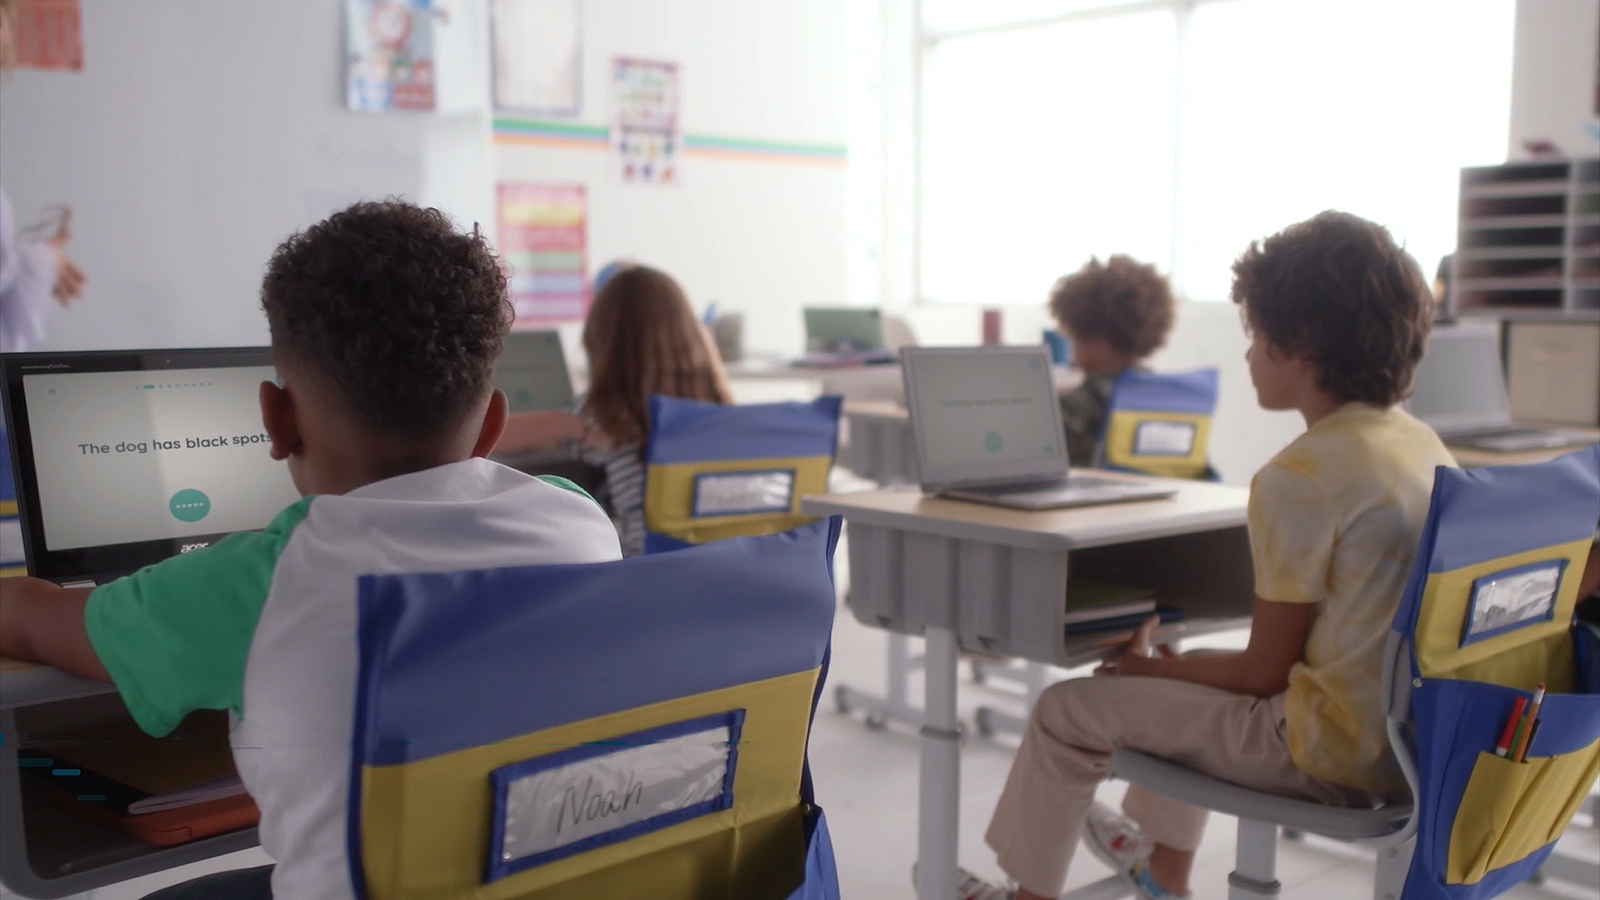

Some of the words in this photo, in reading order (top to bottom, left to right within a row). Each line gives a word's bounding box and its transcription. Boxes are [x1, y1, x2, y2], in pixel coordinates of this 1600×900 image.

[78, 443, 110, 455] The
[115, 440, 147, 454] dog
[152, 438, 181, 451] has
[186, 434, 228, 449] black
[556, 770, 643, 835] Noah
